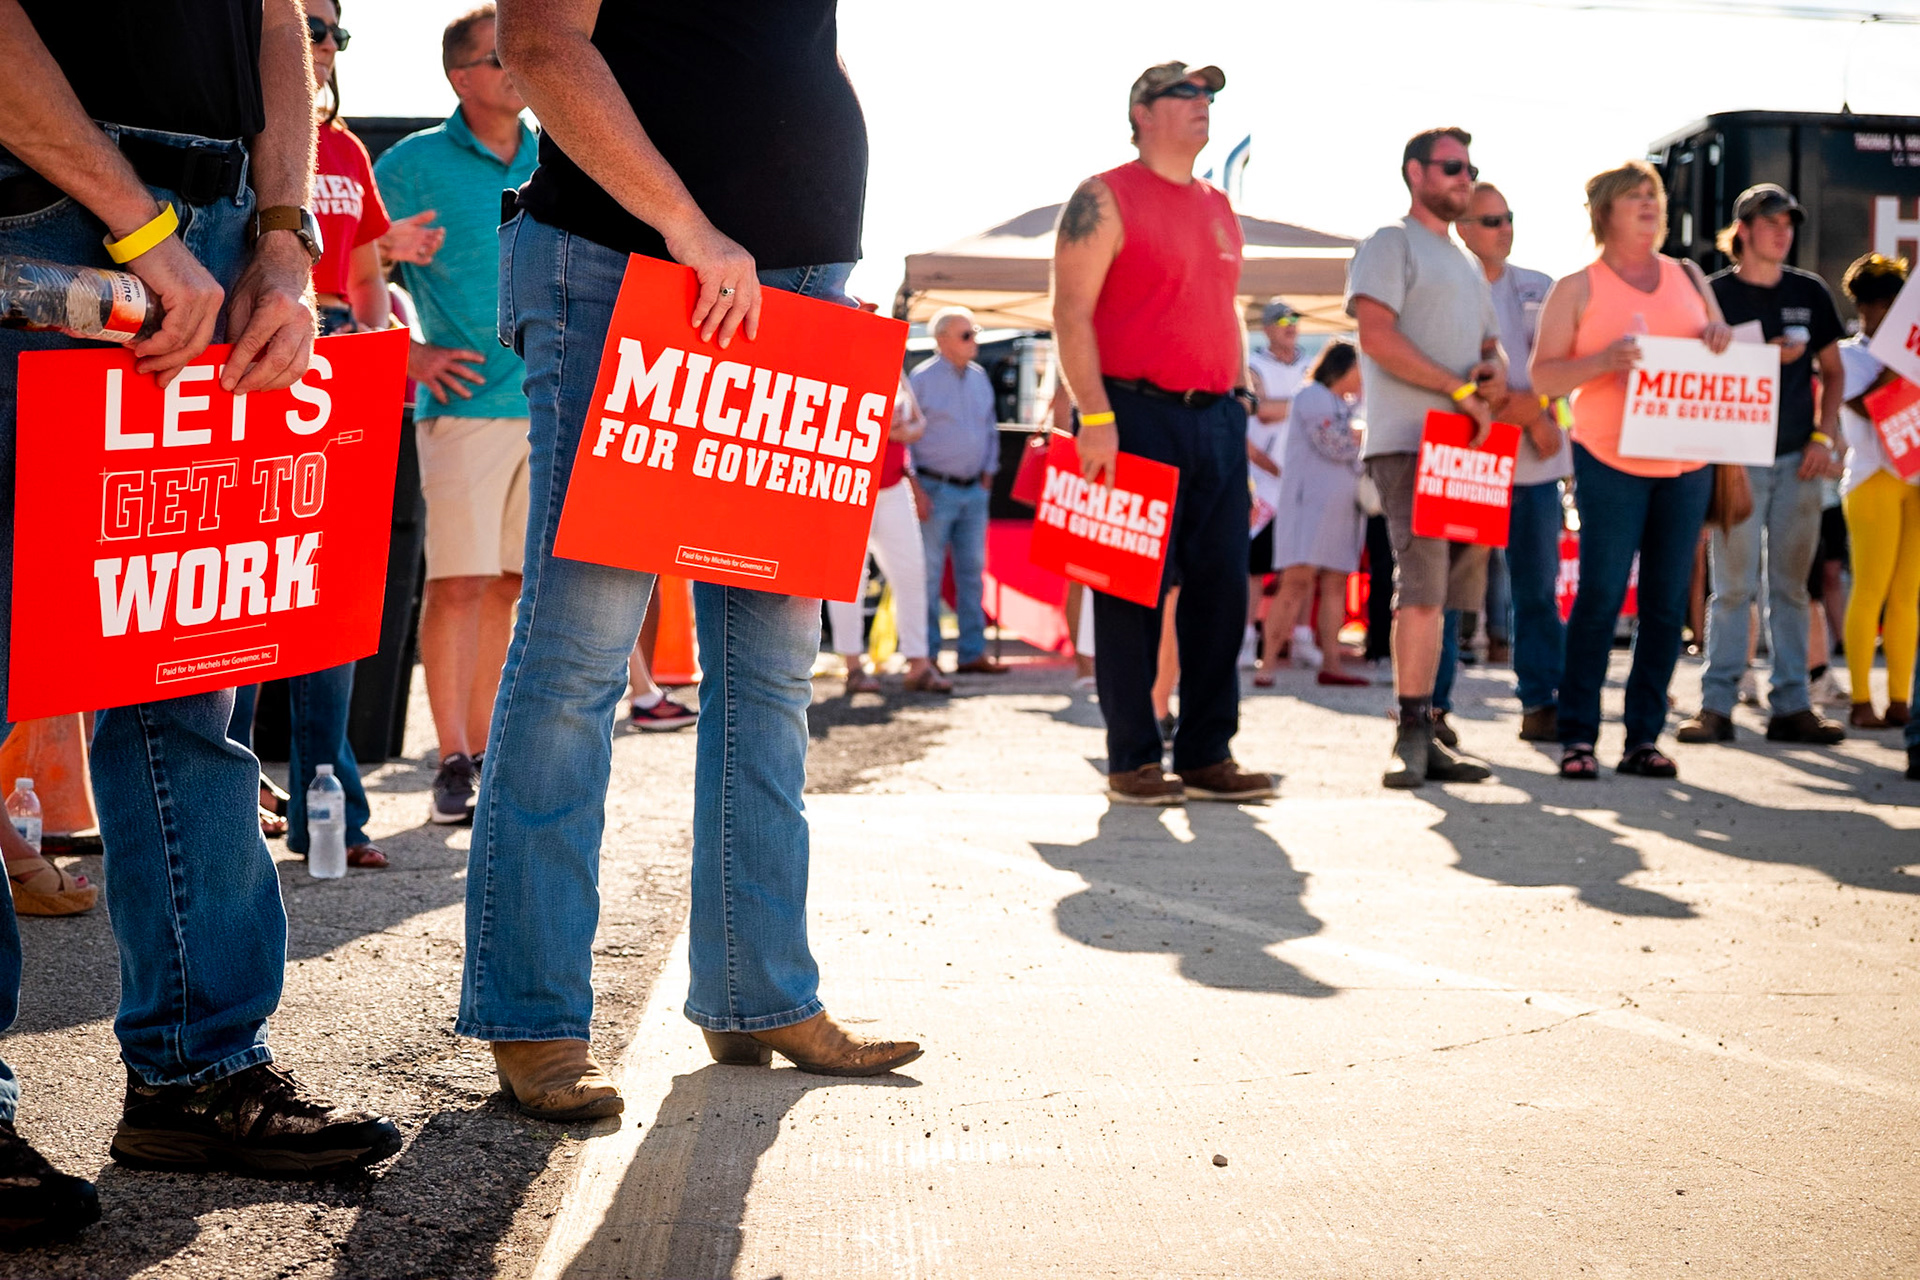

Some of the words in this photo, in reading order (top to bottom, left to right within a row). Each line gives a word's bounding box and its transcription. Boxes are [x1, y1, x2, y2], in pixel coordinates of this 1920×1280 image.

[104, 353, 333, 451] LETS
[603, 336, 888, 464] MICHELS
[1633, 400, 1669, 417] FOR
[1677, 403, 1772, 424] GOVERNOR
[1636, 368, 1772, 406] MICHELS
[592, 417, 679, 471] FOR
[692, 438, 872, 507] GOVERNOR
[1417, 474, 1444, 497] FOR
[1445, 479, 1509, 508] GOVERNOR
[1421, 441, 1514, 488] MICHELS
[102, 462, 237, 541] GET
[252, 451, 328, 524] TO
[1042, 465, 1169, 538] MICHELS
[682, 550, 695, 560] Paid
[703, 554, 710, 563] by
[711, 556, 731, 566] Michels
[1038, 501, 1068, 530] FOR
[1068, 512, 1162, 561] GOVERNOR
[93, 531, 323, 638] WORK
[162, 666, 177, 676] Paid
[178, 665, 187, 674] for
[188, 663, 196, 674] by
[197, 660, 221, 671] Michels
[222, 657, 231, 666] for
[231, 653, 260, 665] Governor,
[261, 651, 273, 659] Inc.
